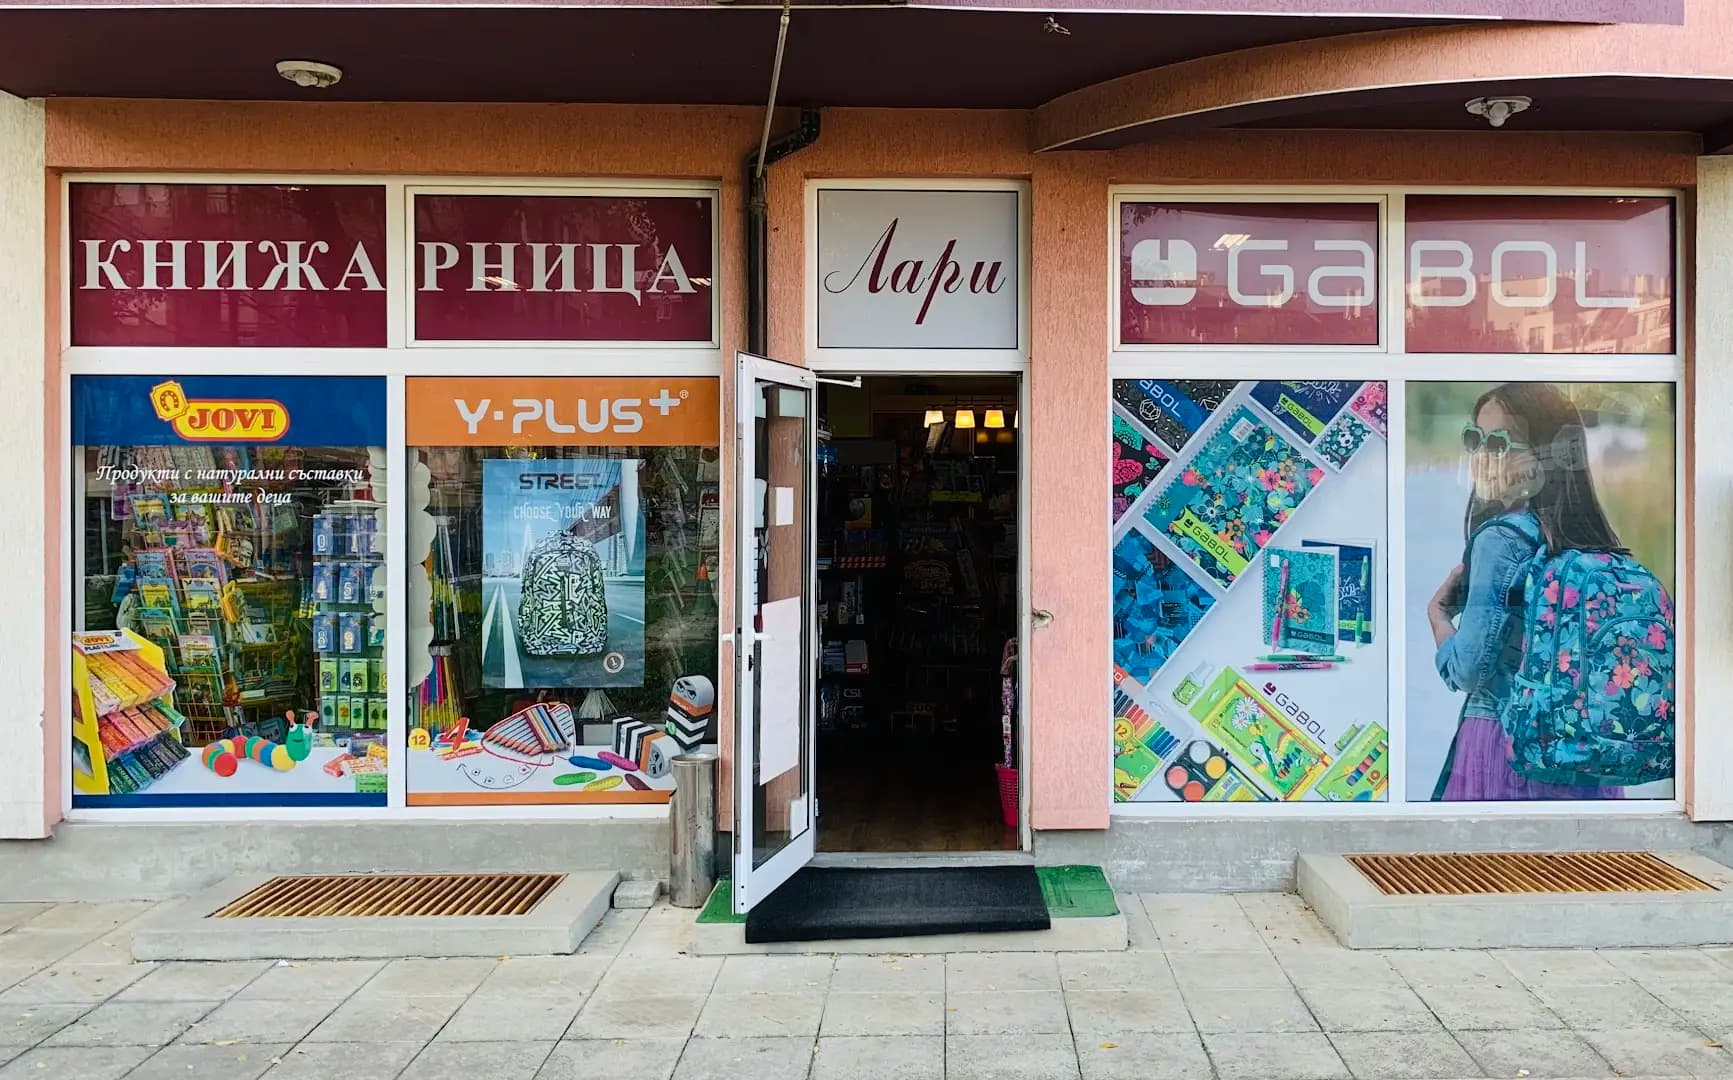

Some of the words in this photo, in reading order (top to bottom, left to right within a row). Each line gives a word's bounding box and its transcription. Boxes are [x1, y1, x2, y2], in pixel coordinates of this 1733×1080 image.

[824, 217, 1006, 325] Лари
[187, 407, 277, 432] JOVI
[95, 465, 180, 486] Продукти
[197, 469, 284, 487] натурални
[288, 469, 364, 482] съставки
[169, 490, 187, 504] за
[191, 490, 253, 504] вашите
[256, 487, 292, 506] деца
[513, 503, 558, 522] CHOOSE
[556, 503, 589, 522] YOUR
[590, 503, 611, 519] WAY
[412, 734, 426, 746] 12
